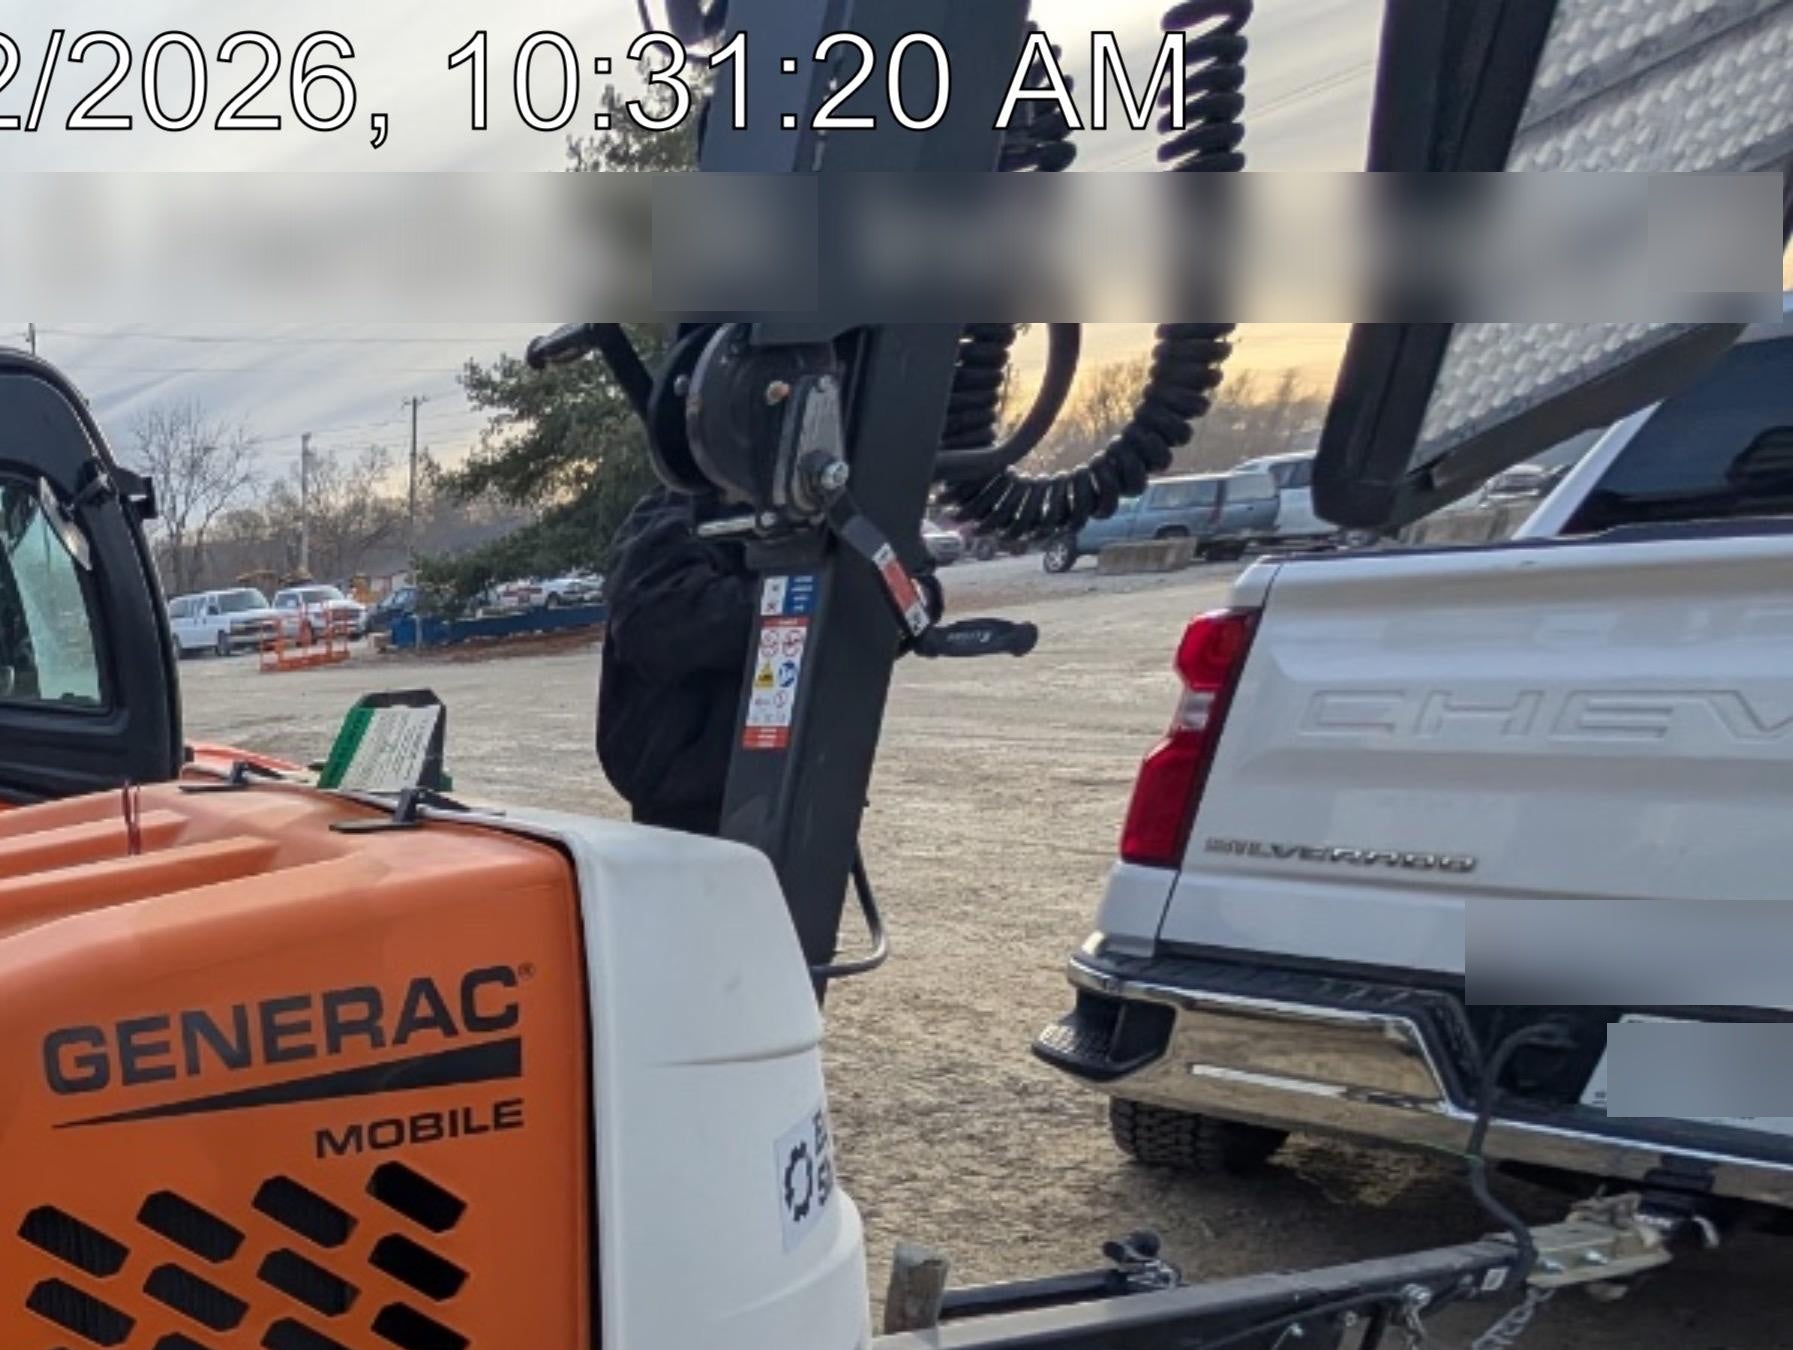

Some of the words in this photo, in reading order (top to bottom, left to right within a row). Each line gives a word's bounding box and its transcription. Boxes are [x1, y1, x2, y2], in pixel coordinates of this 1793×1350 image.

[1205, 837, 1478, 873] SILVERADO
[42, 964, 521, 1096] GENERAC
[315, 1098, 525, 1159] MOBILE
